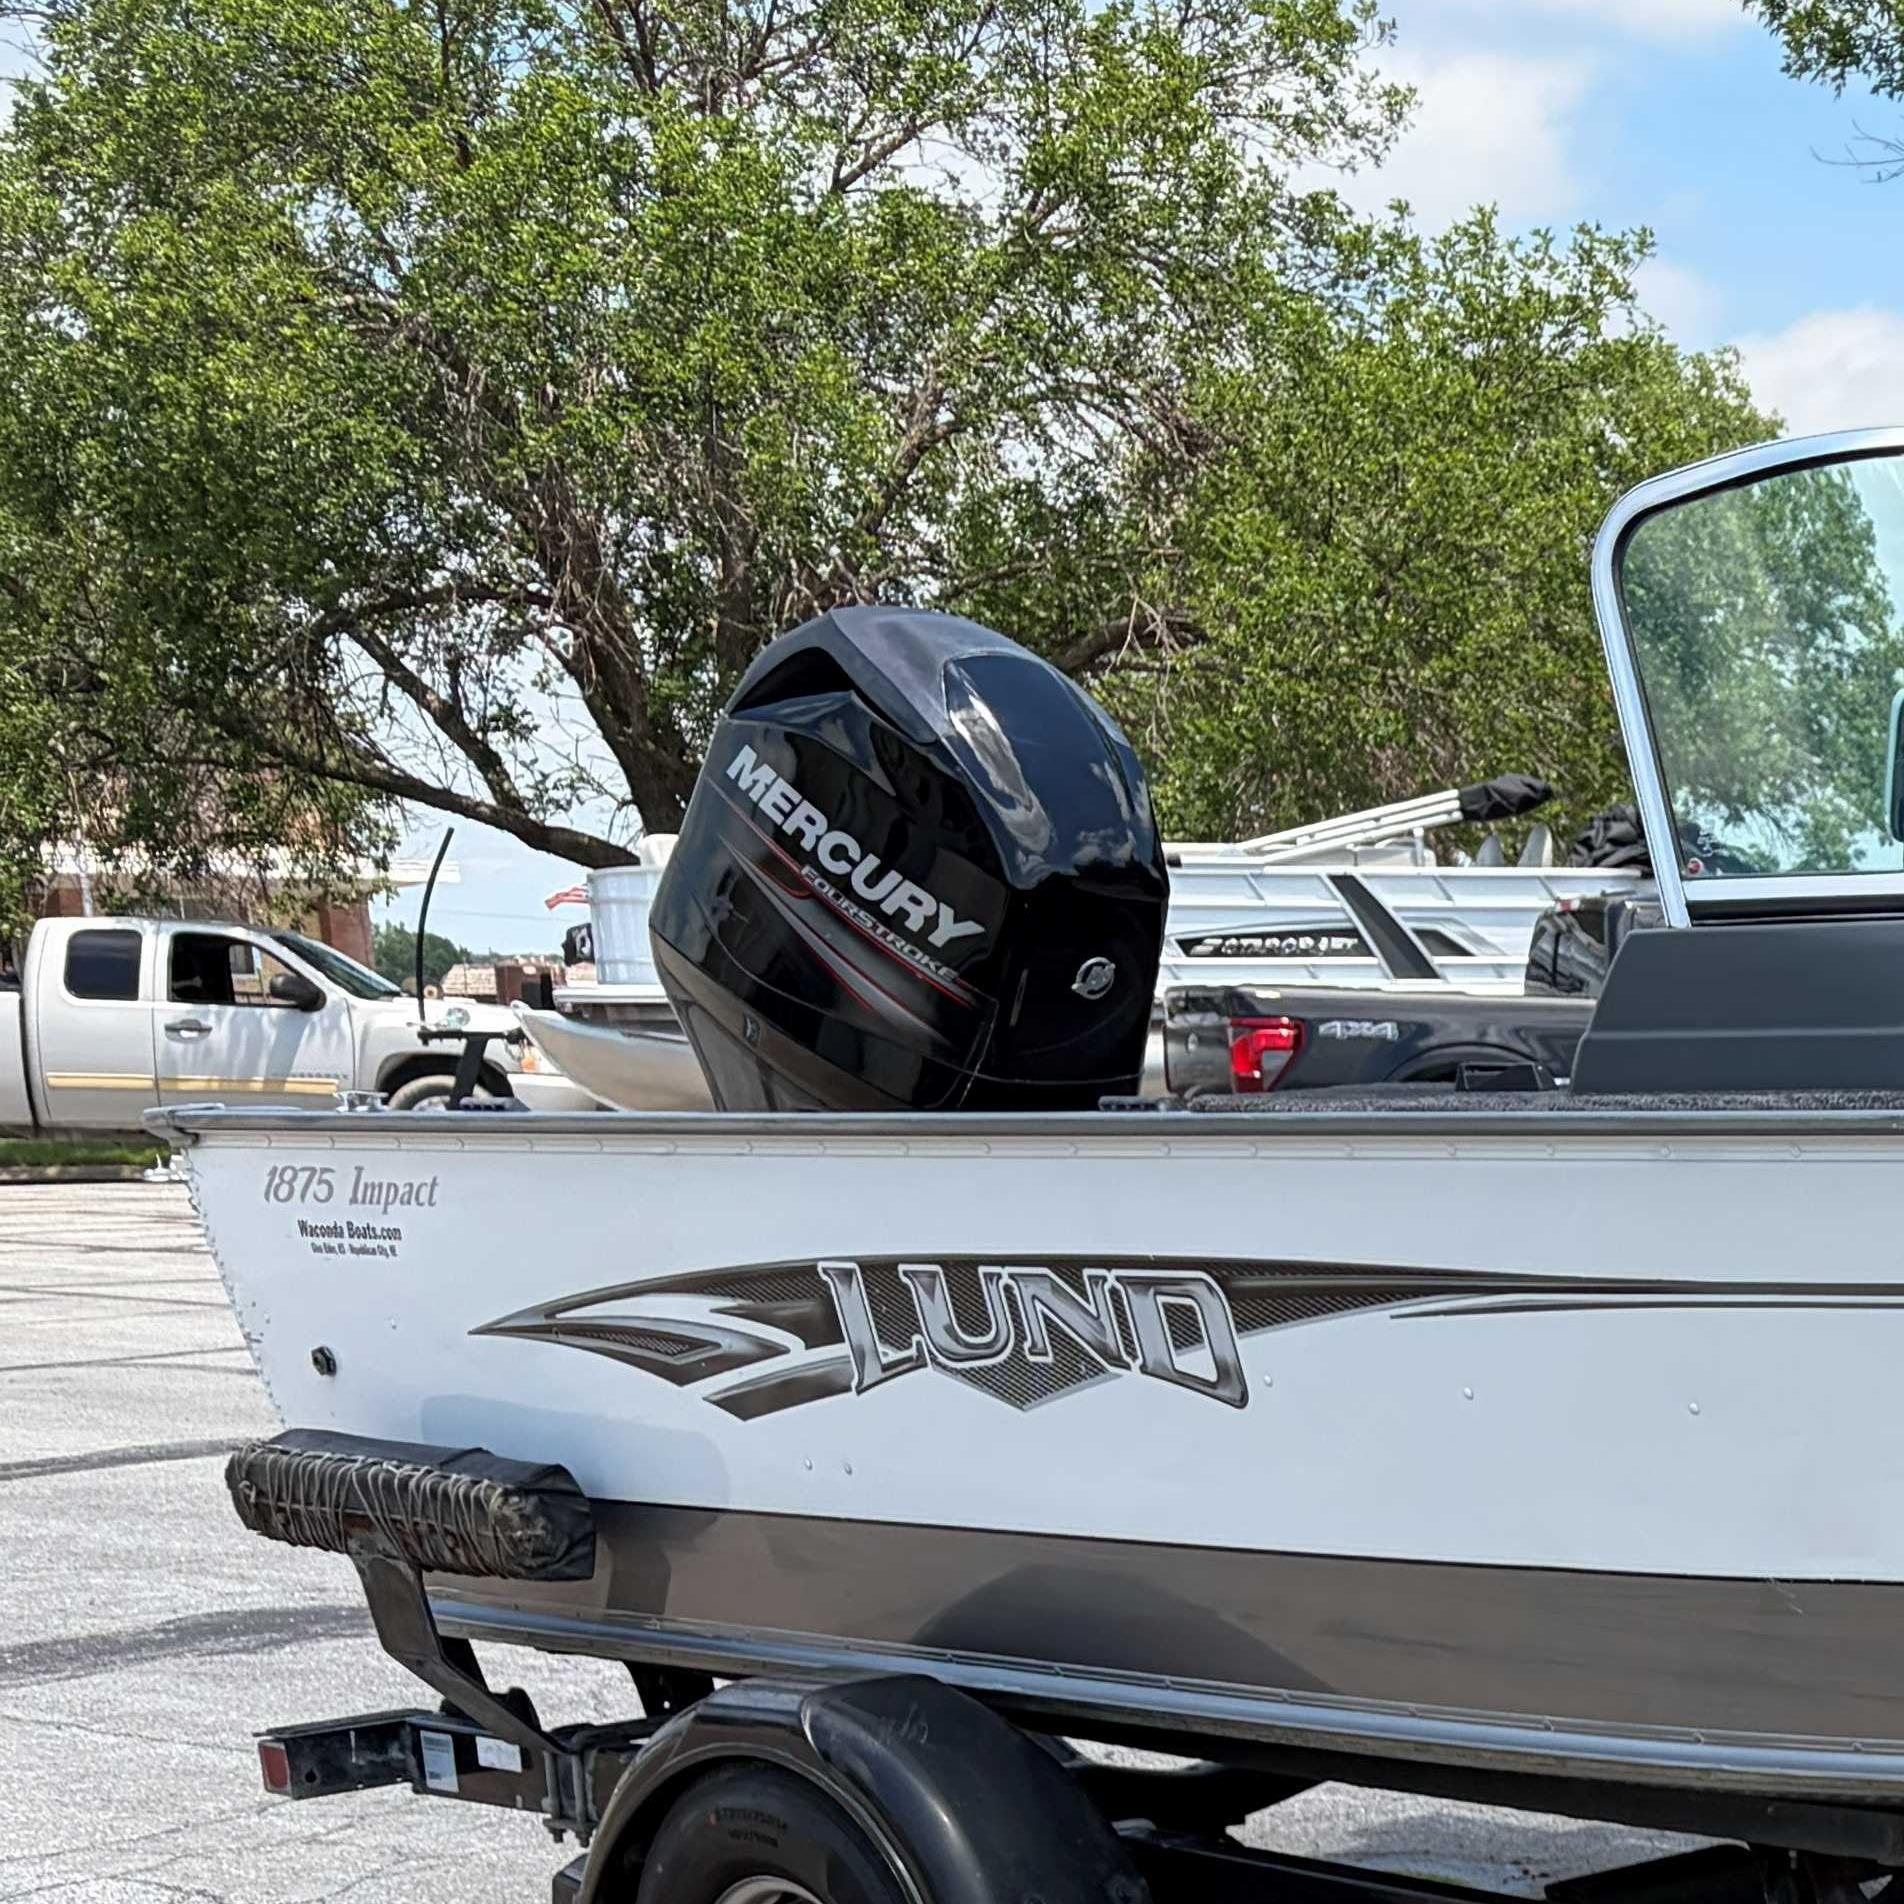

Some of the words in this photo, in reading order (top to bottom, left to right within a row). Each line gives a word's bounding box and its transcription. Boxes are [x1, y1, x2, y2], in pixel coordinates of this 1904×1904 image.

[726, 744, 985, 948] MERCURY
[800, 865, 960, 982] FOURSTROKE
[264, 1165, 336, 1203] 1875
[349, 1165, 439, 1215] Impact
[297, 1219, 345, 1239] Waconda
[346, 1221, 402, 1241] Boats.com
[817, 1262, 1249, 1408] LUND
